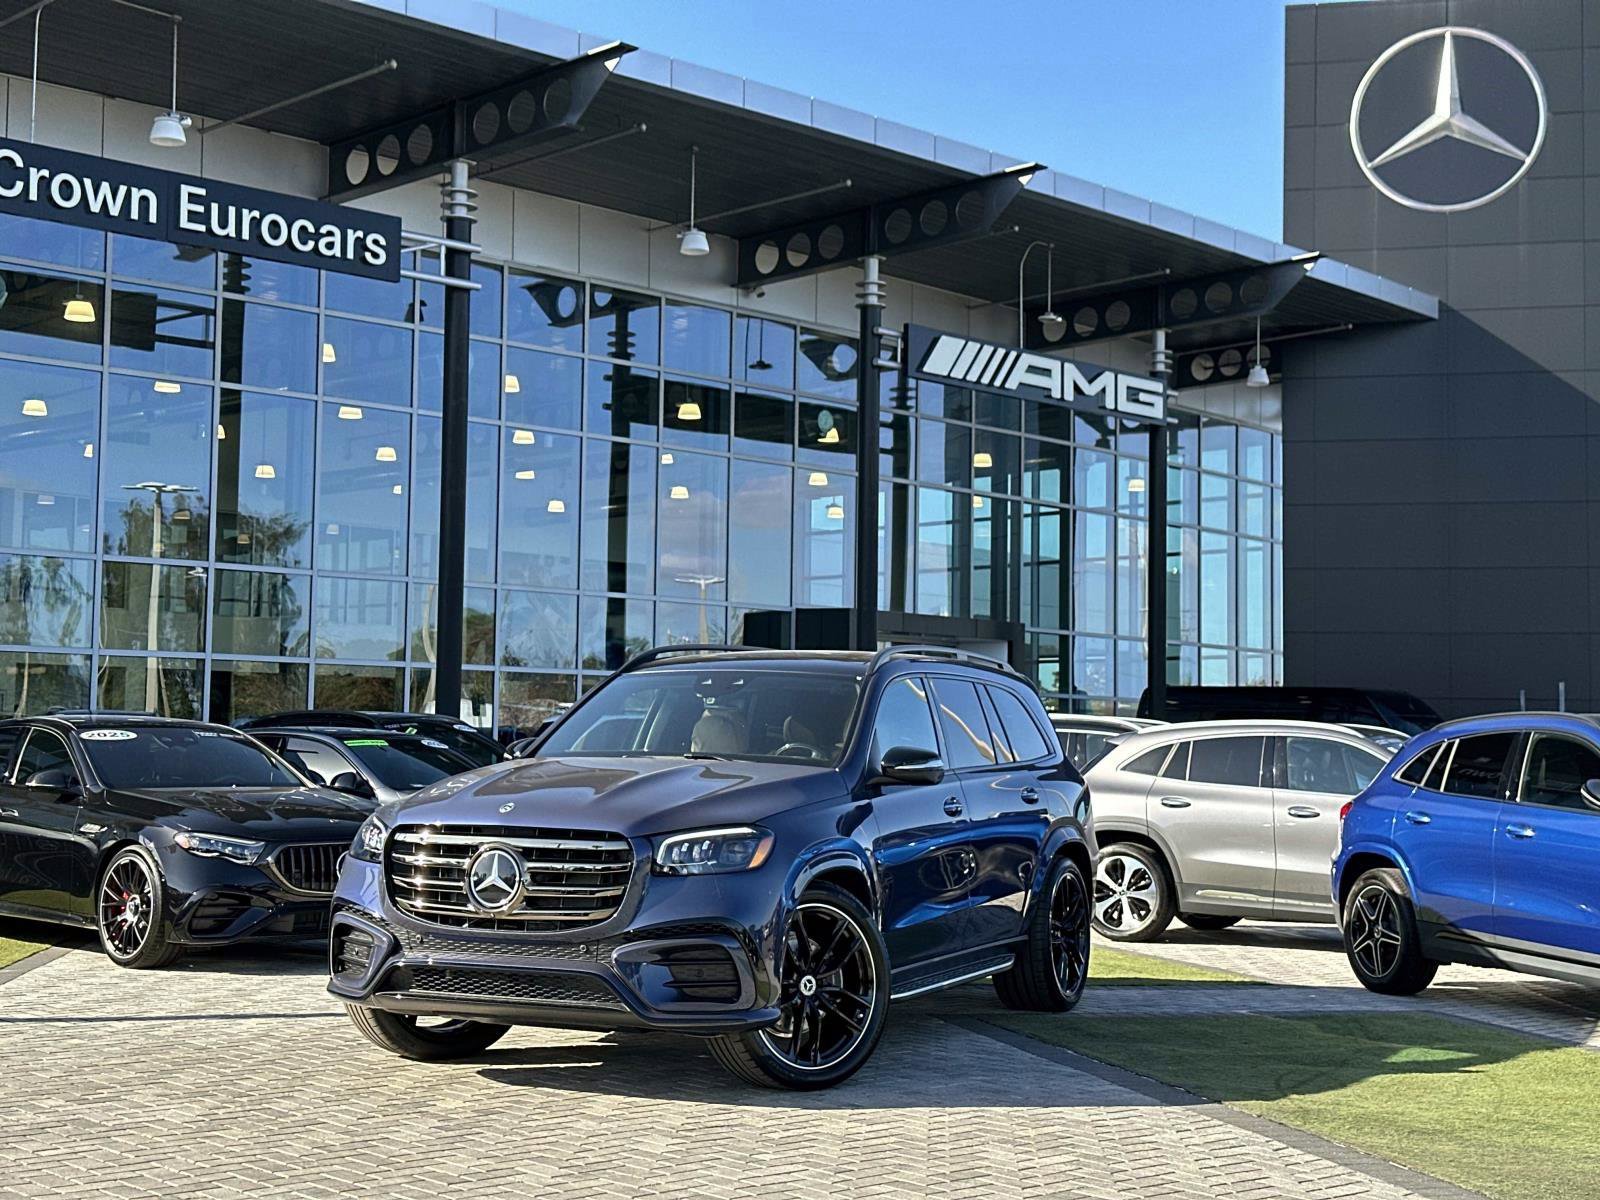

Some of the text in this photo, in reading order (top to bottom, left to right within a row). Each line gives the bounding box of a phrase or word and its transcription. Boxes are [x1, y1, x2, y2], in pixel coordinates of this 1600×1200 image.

[0, 148, 387, 266] Crown Eurocars
[1004, 352, 1164, 420] AMG
